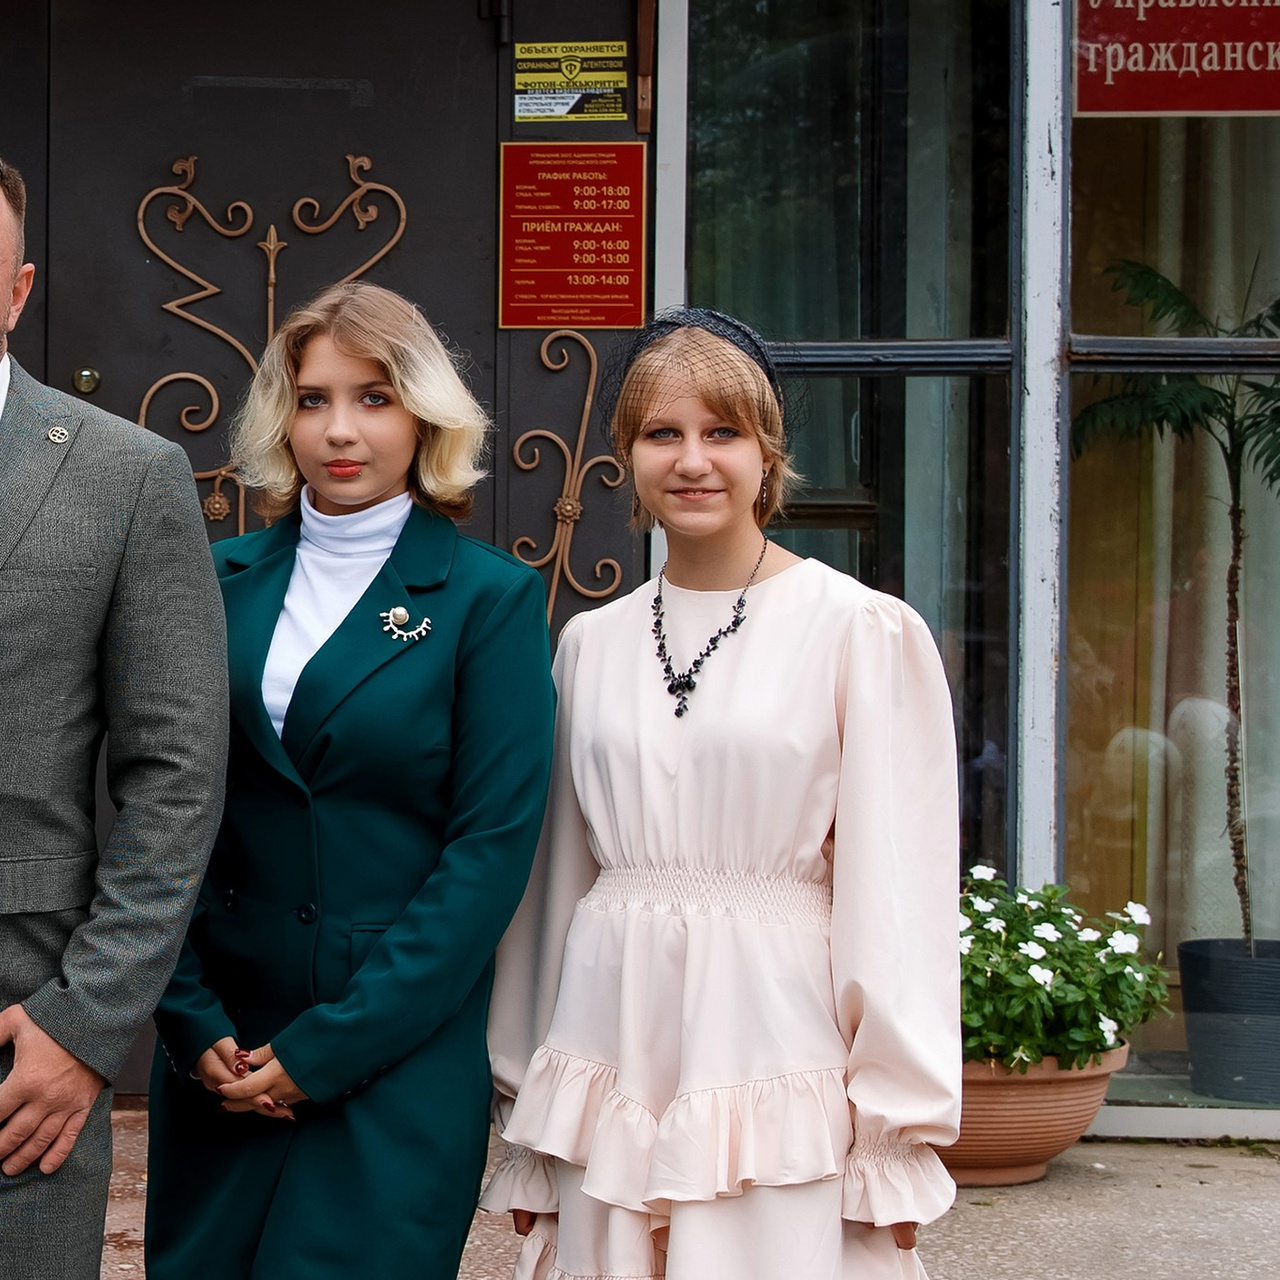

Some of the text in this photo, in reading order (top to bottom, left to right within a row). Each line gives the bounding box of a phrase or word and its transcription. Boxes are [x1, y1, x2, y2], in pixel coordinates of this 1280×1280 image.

[520, 45, 624, 54] ОБЪЕКТ ОХРАНЯЕТСЯ
[517, 60, 624, 70] ОХРАННЫМ АГЕНТСТВОМ
[538, 172, 607, 180] ГРАФИК РАБОТЫ:
[573, 186, 630, 196] 9:00-18:00
[573, 200, 630, 210] 9:00-17:00
[522, 220, 622, 233] ПРИЁМ ГРАЖДАН:
[573, 240, 629, 250] 9:00-16:00
[573, 253, 629, 264] 9:00-13:00
[566, 275, 629, 285] 13:00-14:00
